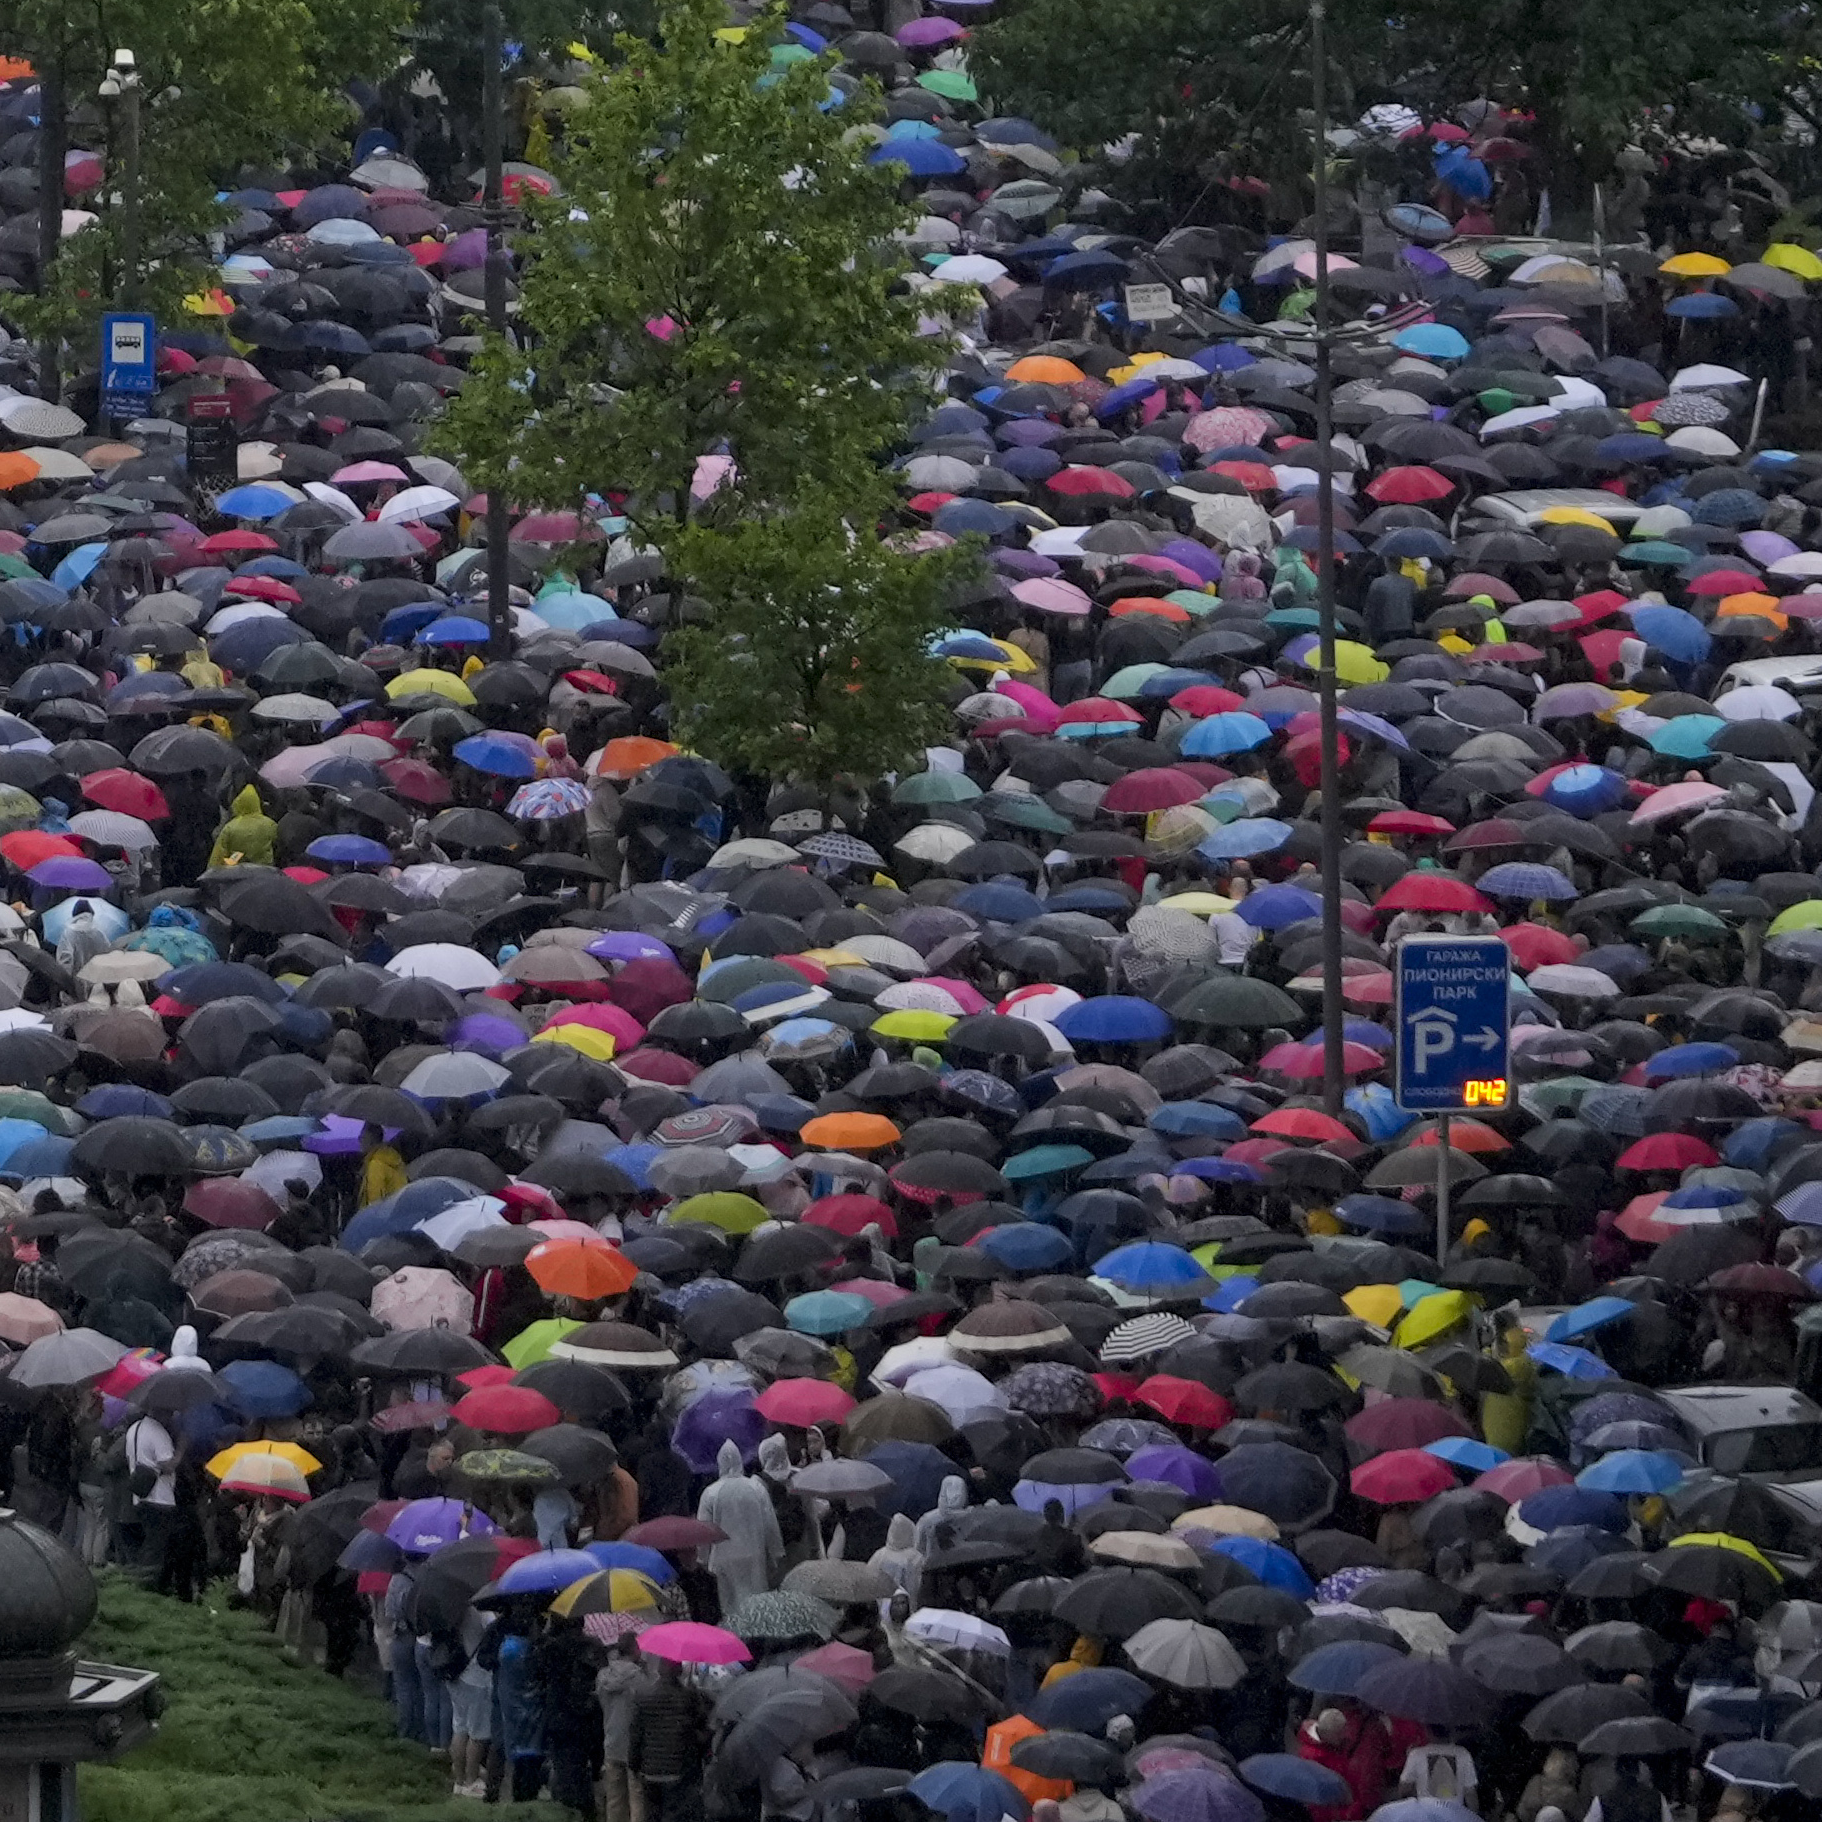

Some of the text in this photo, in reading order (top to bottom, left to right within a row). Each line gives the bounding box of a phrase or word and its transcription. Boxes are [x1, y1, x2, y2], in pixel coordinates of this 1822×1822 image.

[1426, 950, 1481, 963] ГАРАЖА
[1403, 967, 1506, 982] ПИОНИРСКИ
[1433, 986, 1477, 1000] ПАРК
[1414, 1021, 1454, 1074] P
[1464, 1080, 1506, 1105] 042
